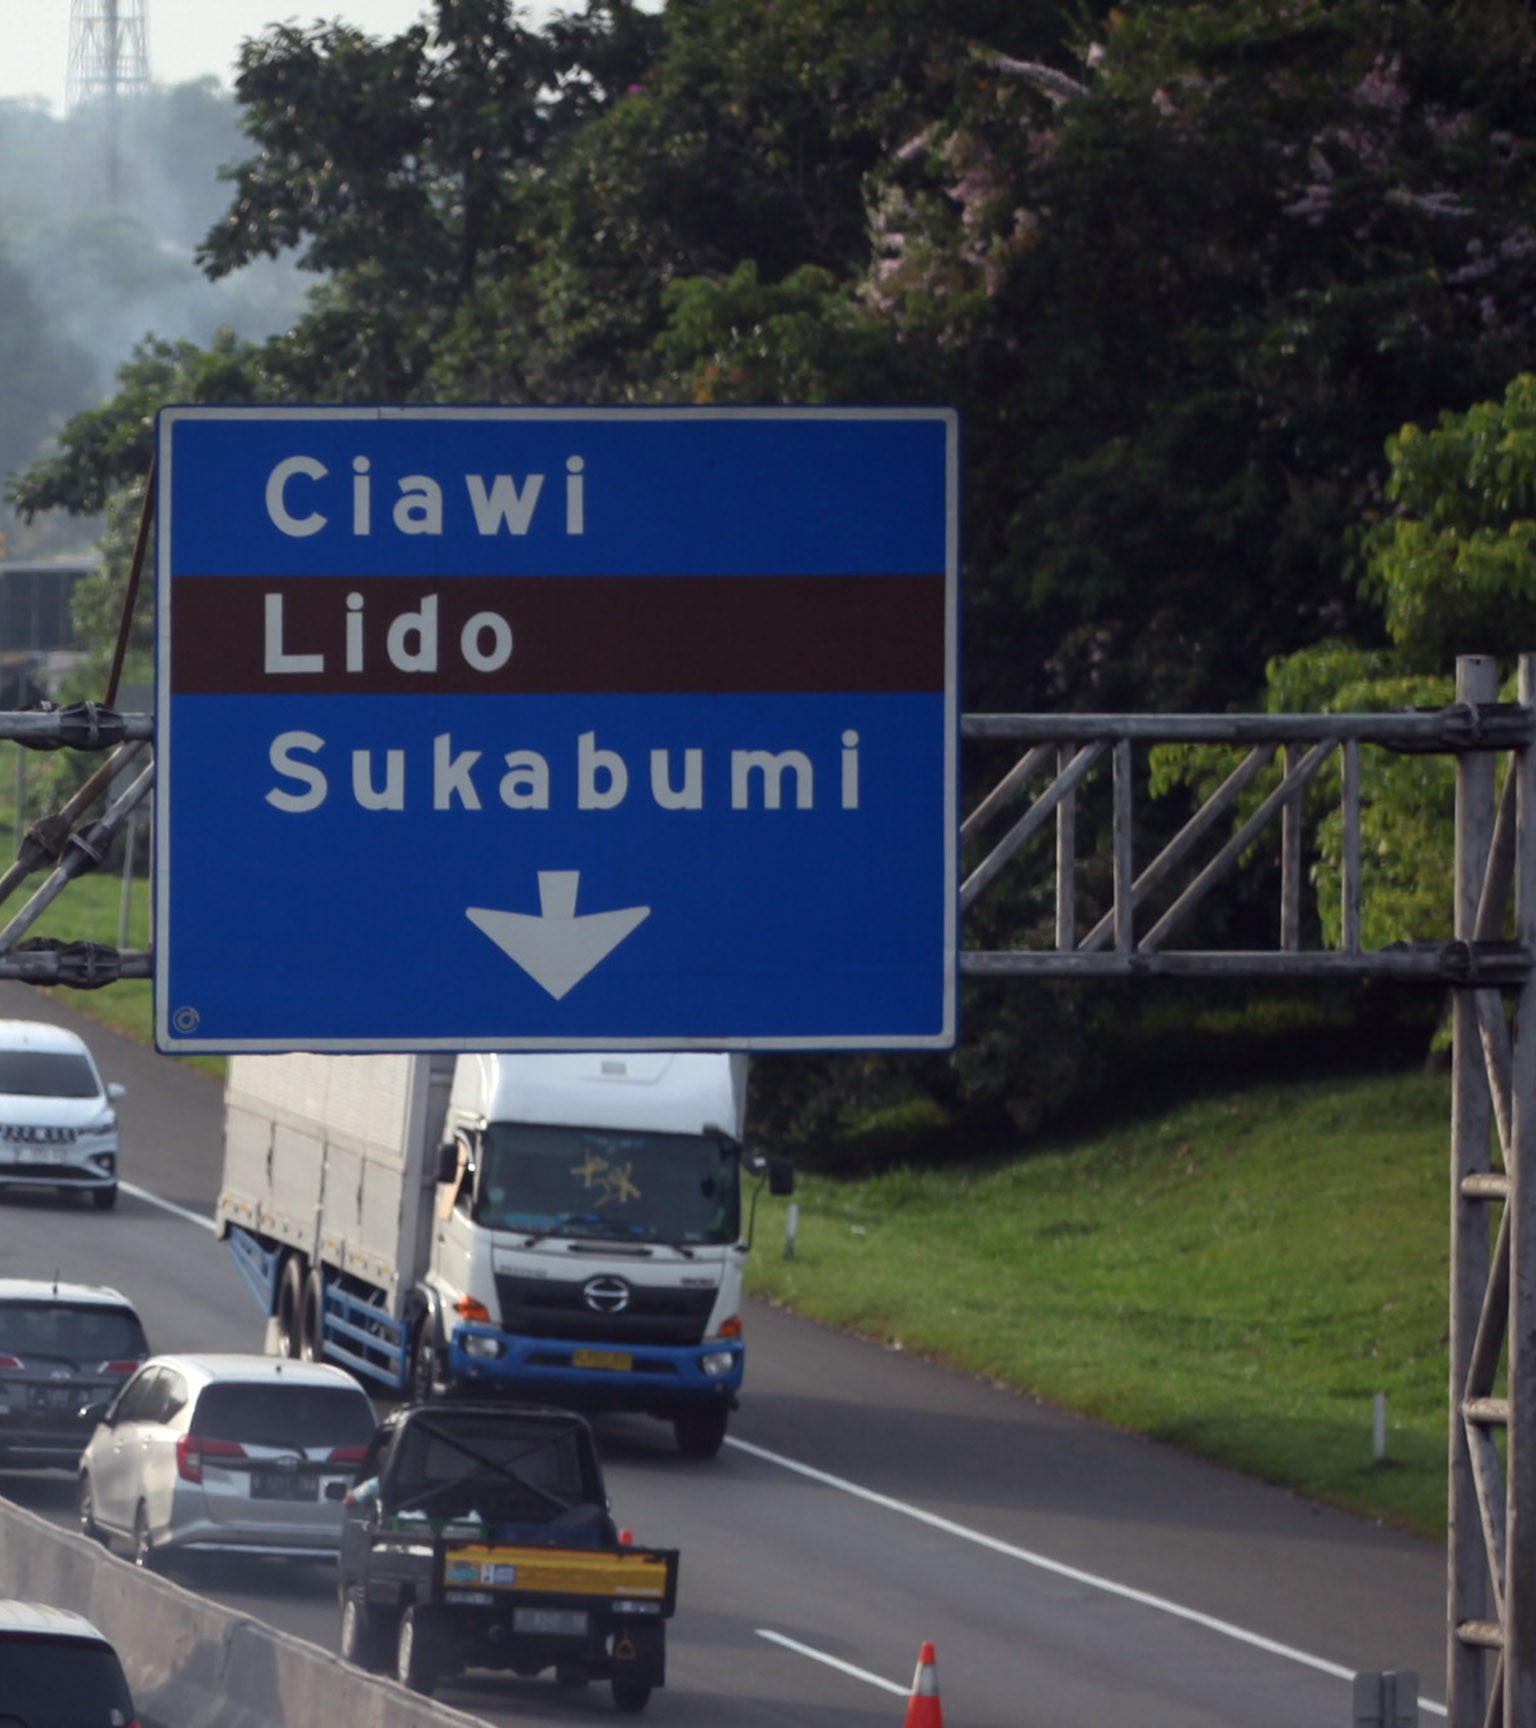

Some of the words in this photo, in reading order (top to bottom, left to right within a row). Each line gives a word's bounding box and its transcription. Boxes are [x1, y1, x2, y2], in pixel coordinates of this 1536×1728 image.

[265, 455, 586, 538] Ciawi
[264, 592, 514, 674] Lido
[265, 729, 860, 813] Sukabumi
